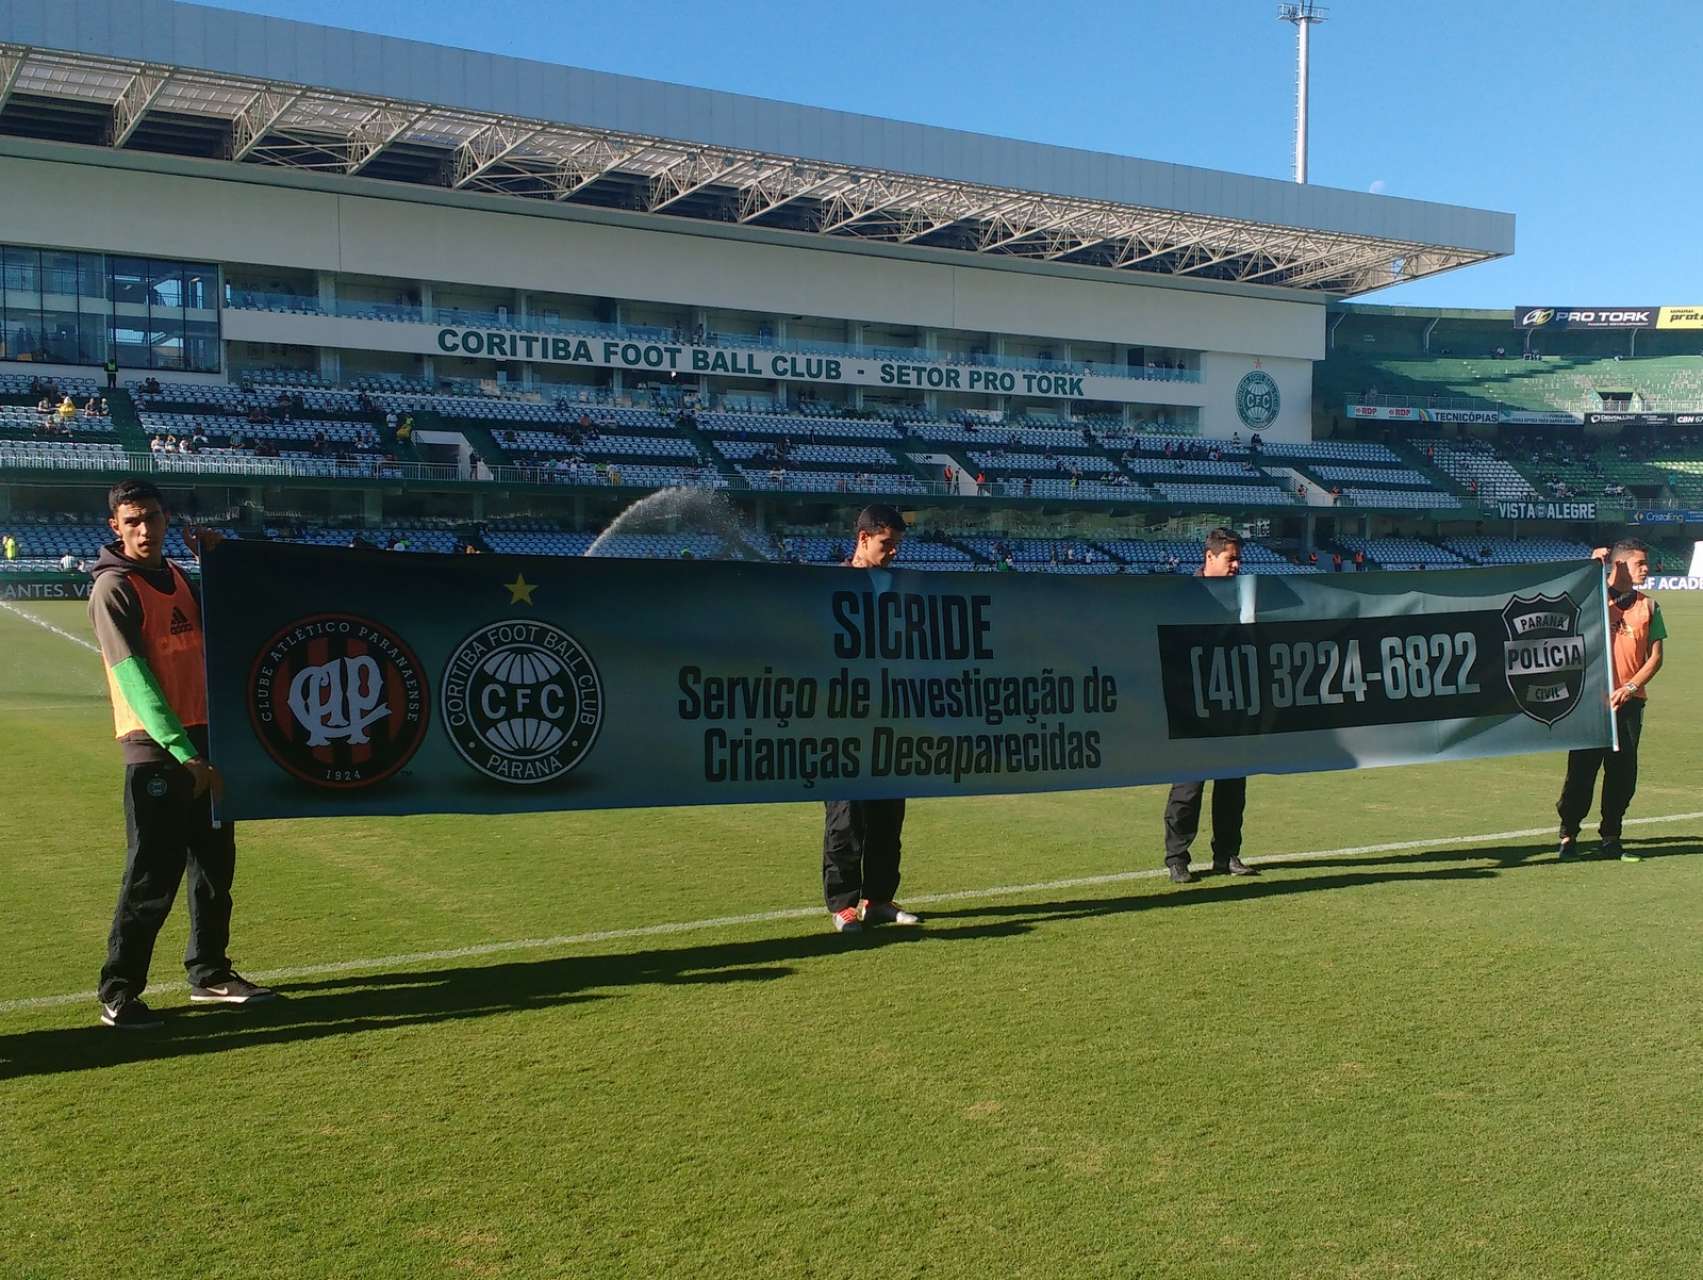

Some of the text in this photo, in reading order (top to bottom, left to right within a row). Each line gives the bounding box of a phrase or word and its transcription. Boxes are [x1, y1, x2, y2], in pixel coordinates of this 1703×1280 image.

[1556, 311, 1650, 322] PRO TORK
[437, 328, 593, 363] CORITIBA
[603, 342, 682, 369] FOOT
[692, 350, 763, 375] BALL
[771, 354, 842, 380] CLUB
[879, 363, 961, 389] SETOR
[969, 369, 1016, 392] PRO
[1023, 373, 1085, 397] TORK
[1434, 411, 1498, 424] TECNICÓPIAS
[1677, 416, 1695, 424] CBN
[1499, 503, 1596, 519] VISTA ALEGRE
[831, 590, 995, 661] SICRIDE
[257, 620, 421, 723] CLUBE ATLÉTICO PARANAENSE
[1269, 631, 1481, 709] 3224-6822
[1507, 641, 1583, 671] POLÍCIA
[446, 624, 598, 728] CORITIBA FOOT BALL CLUB
[1535, 687, 1561, 701] CIVIL
[480, 683, 566, 721] CFC
[678, 665, 1118, 728] Serviço de Investigação de
[486, 750, 563, 778] PARANÁ
[704, 722, 1101, 788] Crianças Desaparecidas
